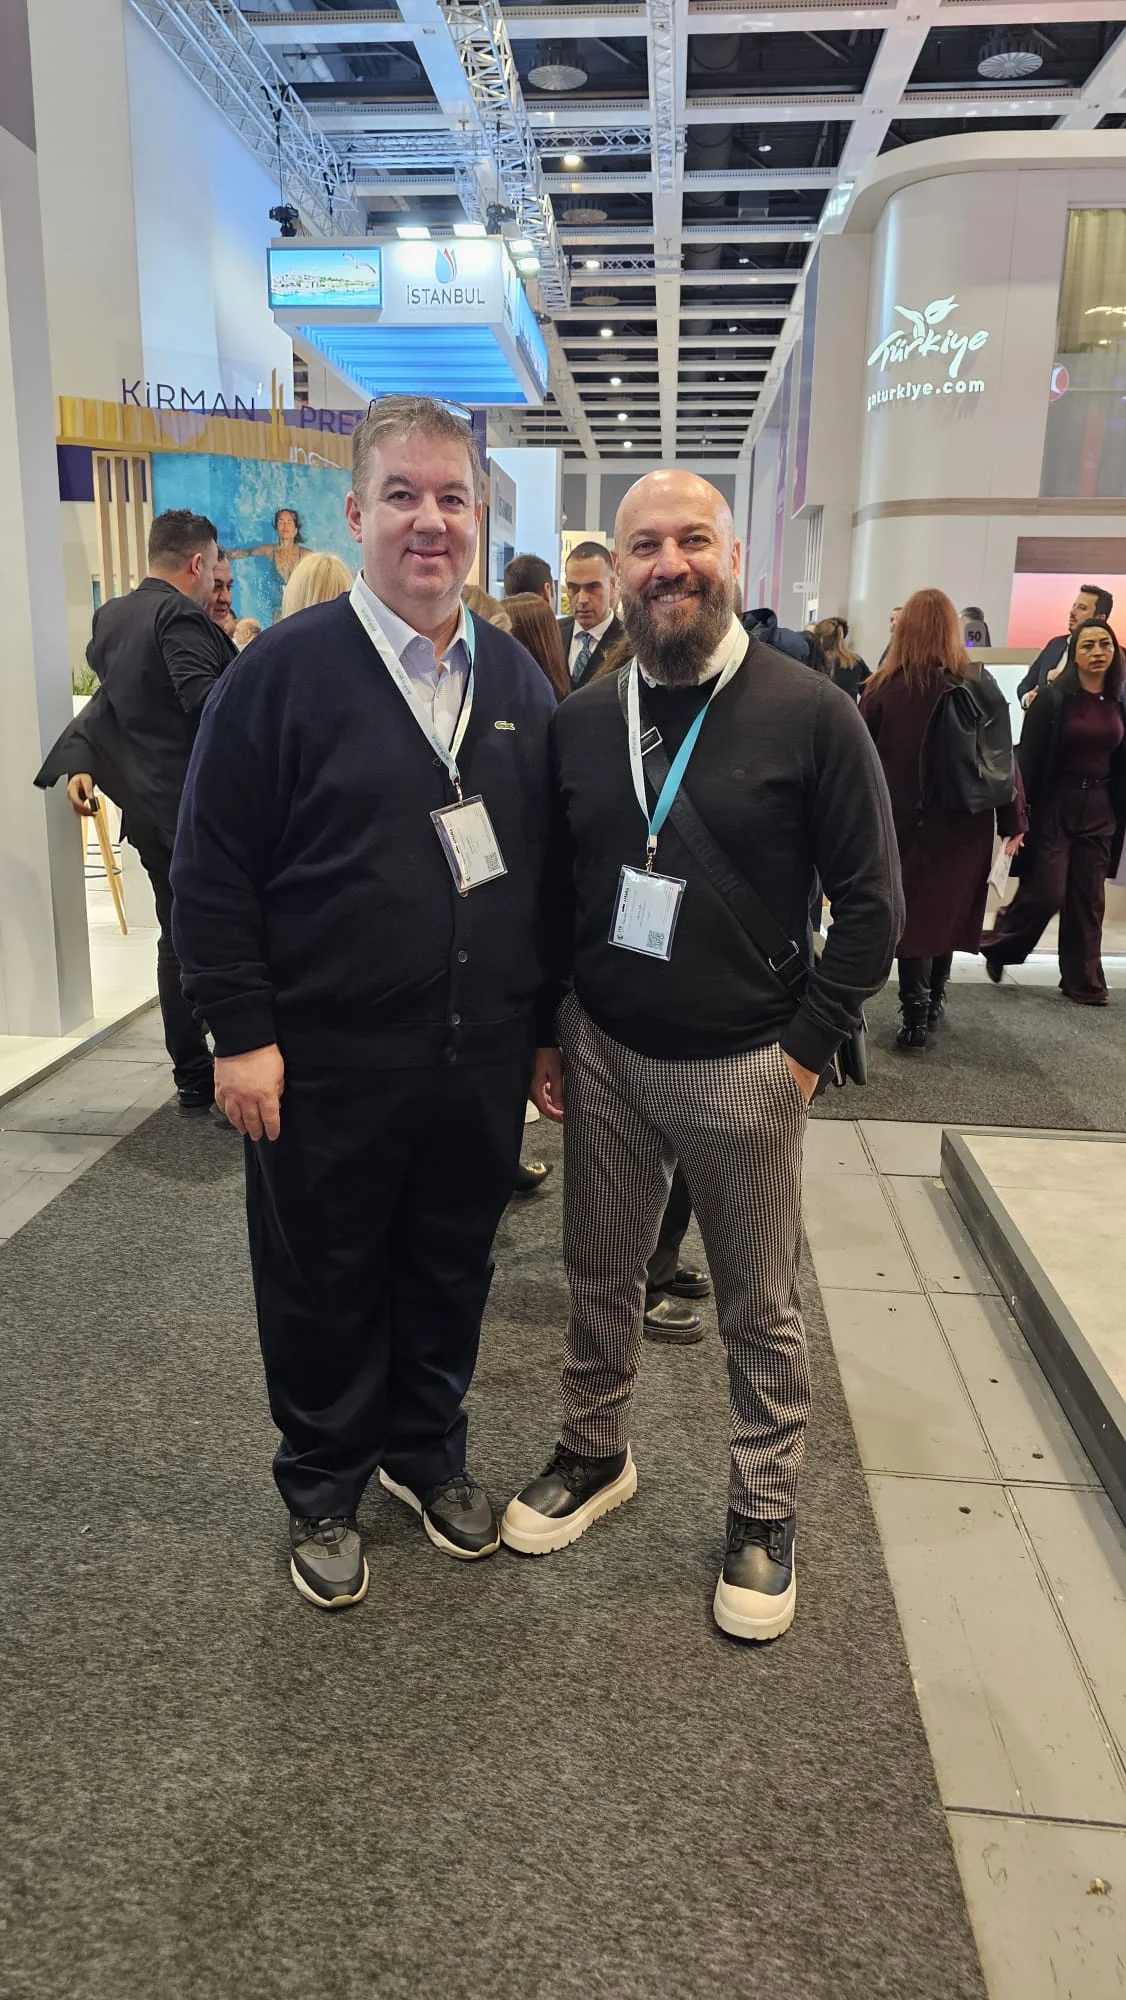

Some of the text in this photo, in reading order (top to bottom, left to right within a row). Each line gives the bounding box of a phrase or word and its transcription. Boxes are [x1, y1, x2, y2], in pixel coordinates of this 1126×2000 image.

[407, 284, 486, 305] İSTANBUL
[867, 329, 989, 378] Türkiye
[867, 380, 985, 411] goturkiye.com
[301, 405, 363, 435] PRE
[967, 631, 981, 642] 50
